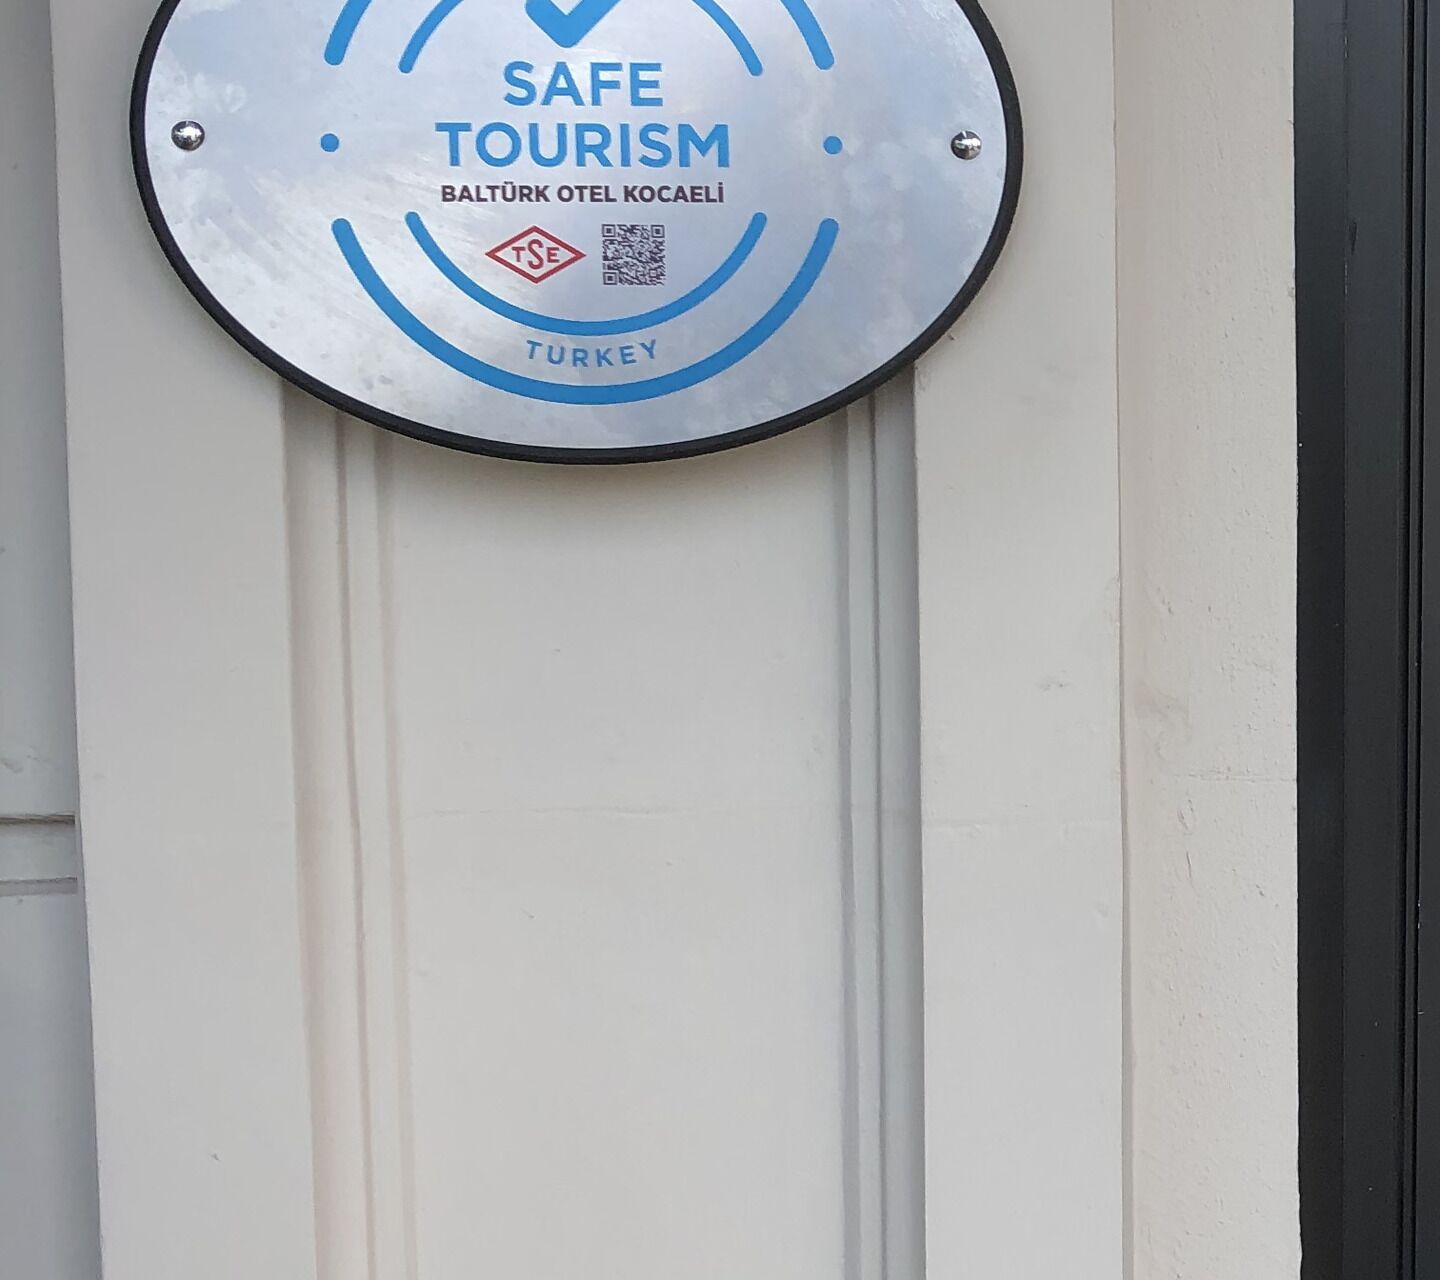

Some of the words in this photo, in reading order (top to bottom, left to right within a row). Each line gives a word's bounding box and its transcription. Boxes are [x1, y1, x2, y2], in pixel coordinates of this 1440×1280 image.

[504, 61, 663, 107] SAFE
[435, 122, 730, 168] TOURISM
[441, 181, 550, 203] BALTÜRK
[557, 184, 617, 204] OTEL
[624, 181, 725, 204] KOCAELİ
[511, 238, 561, 271] TSE
[526, 339, 657, 368] TURKEY
